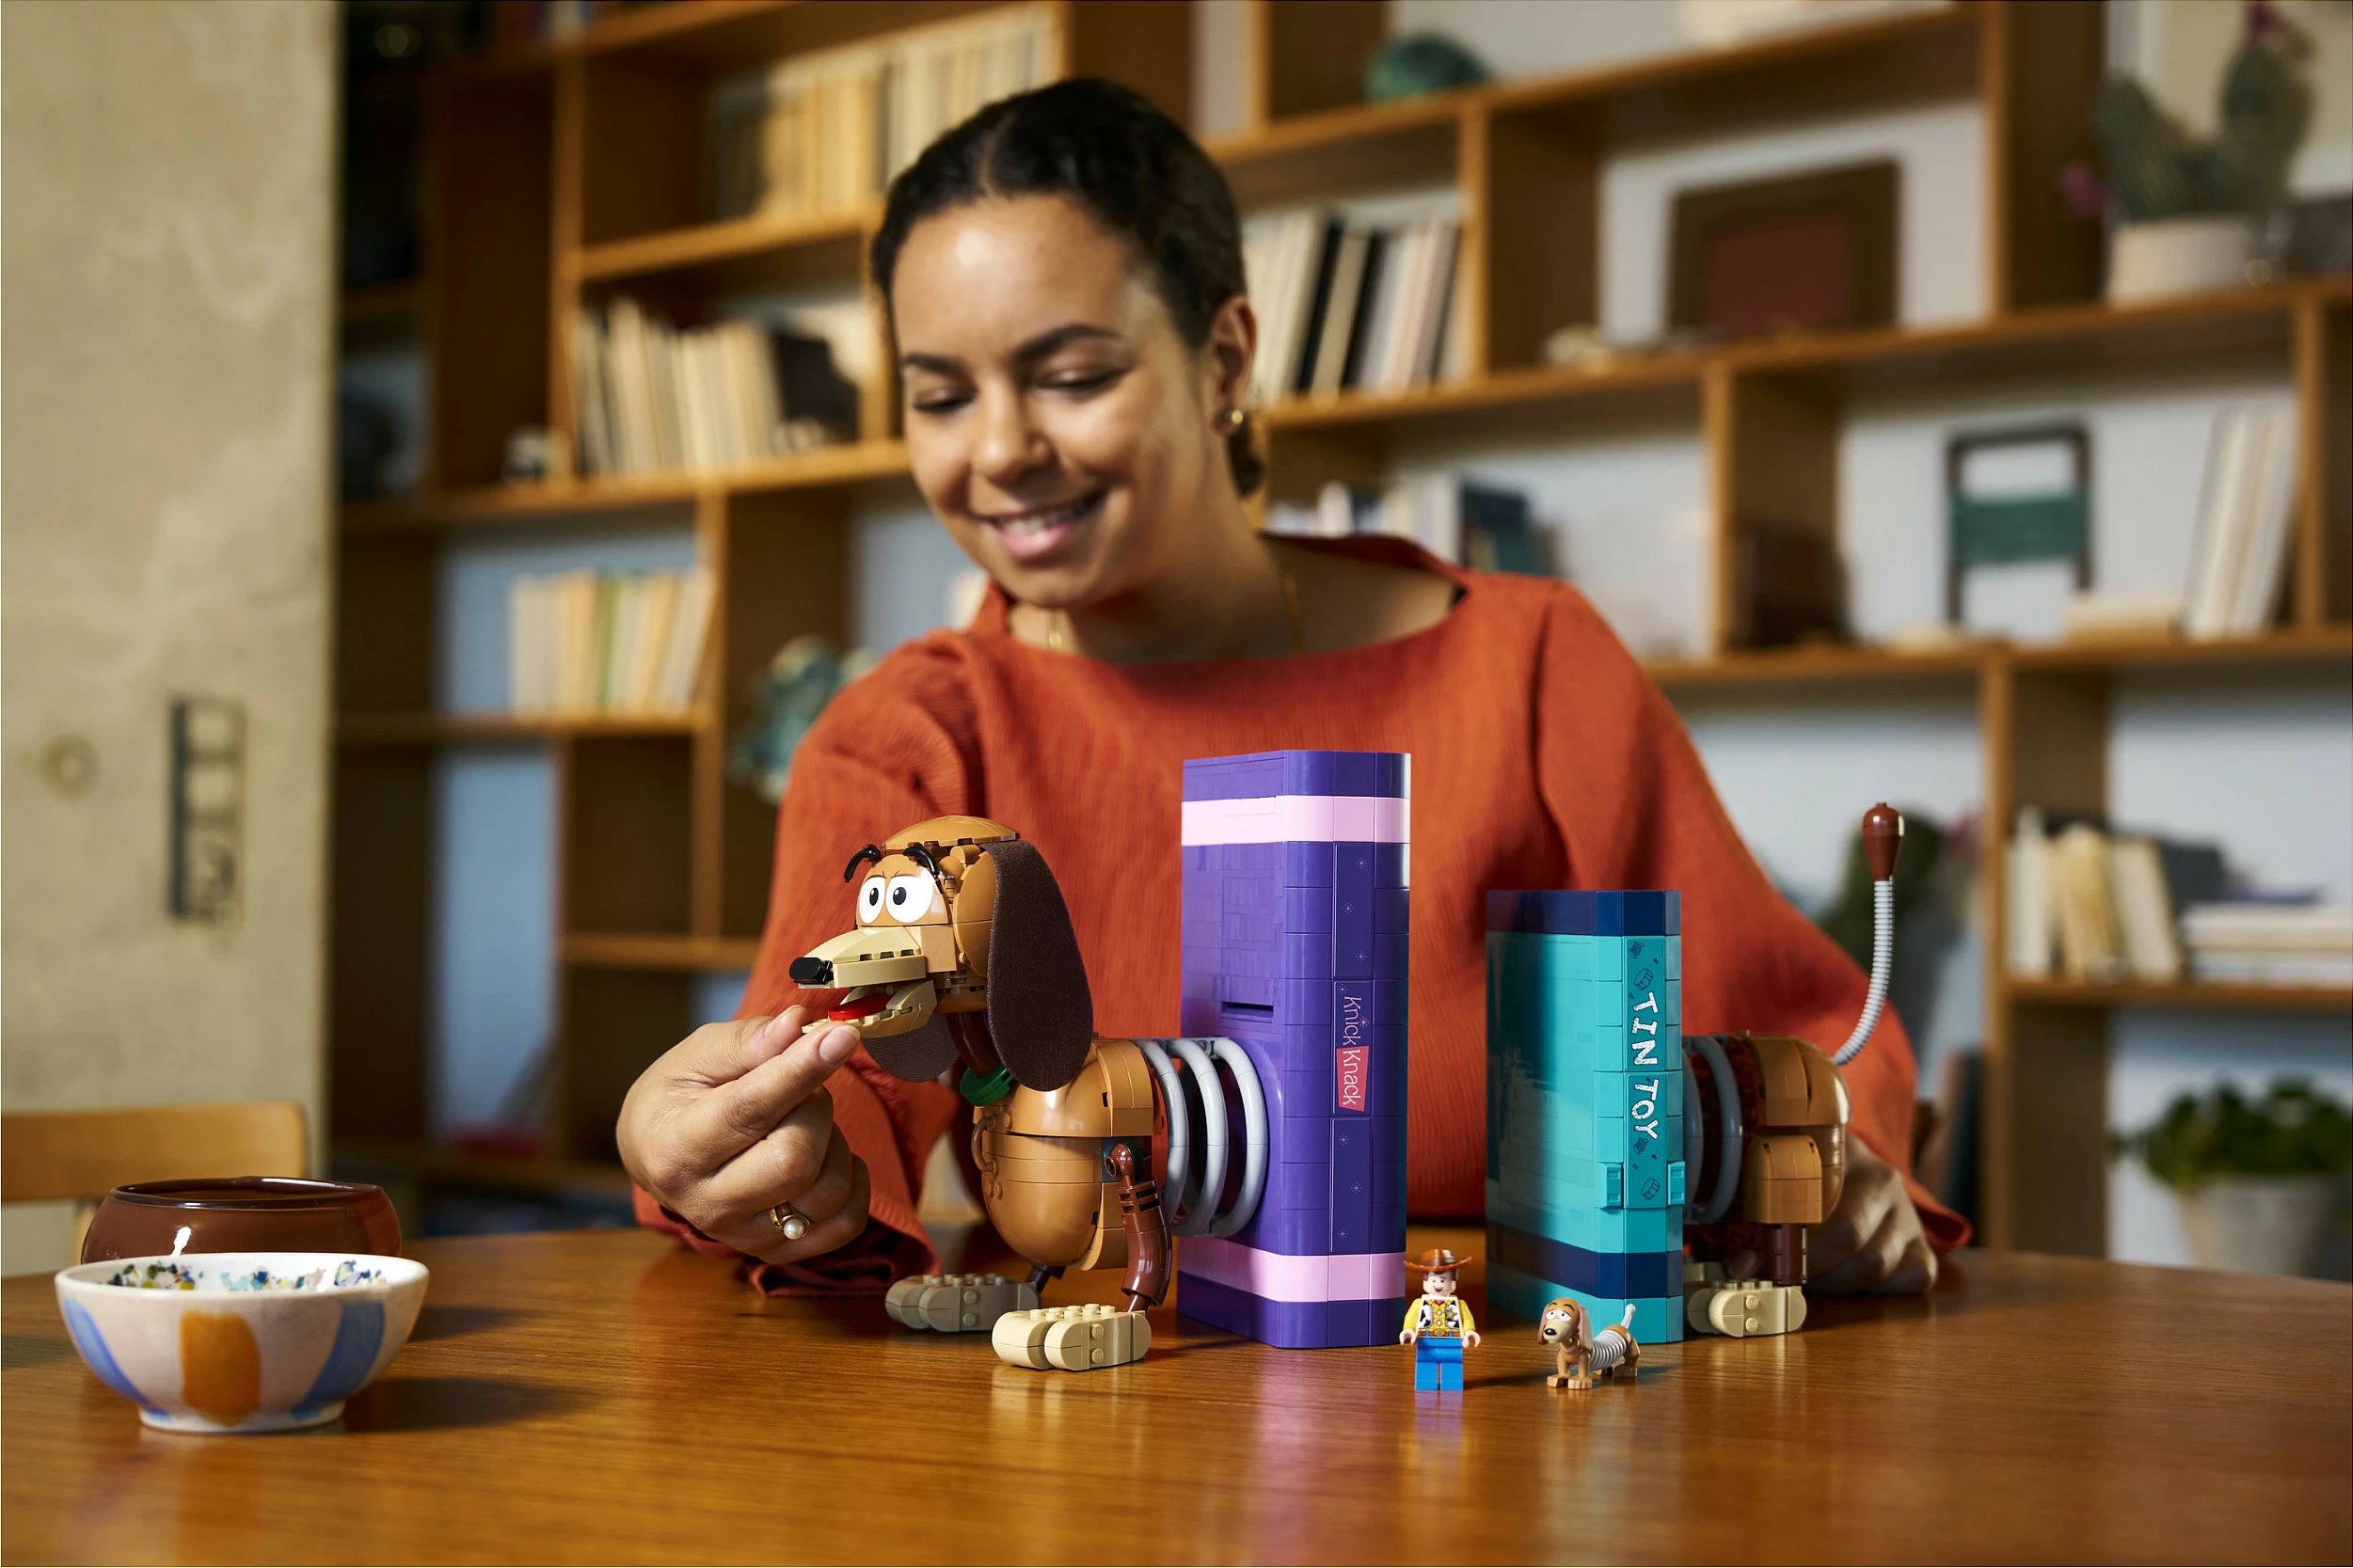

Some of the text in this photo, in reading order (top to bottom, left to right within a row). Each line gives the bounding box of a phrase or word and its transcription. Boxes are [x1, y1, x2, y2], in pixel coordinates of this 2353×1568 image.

[1343, 996, 1363, 1105] Knick Knack
[1630, 991, 1659, 1139] TIN TOY
